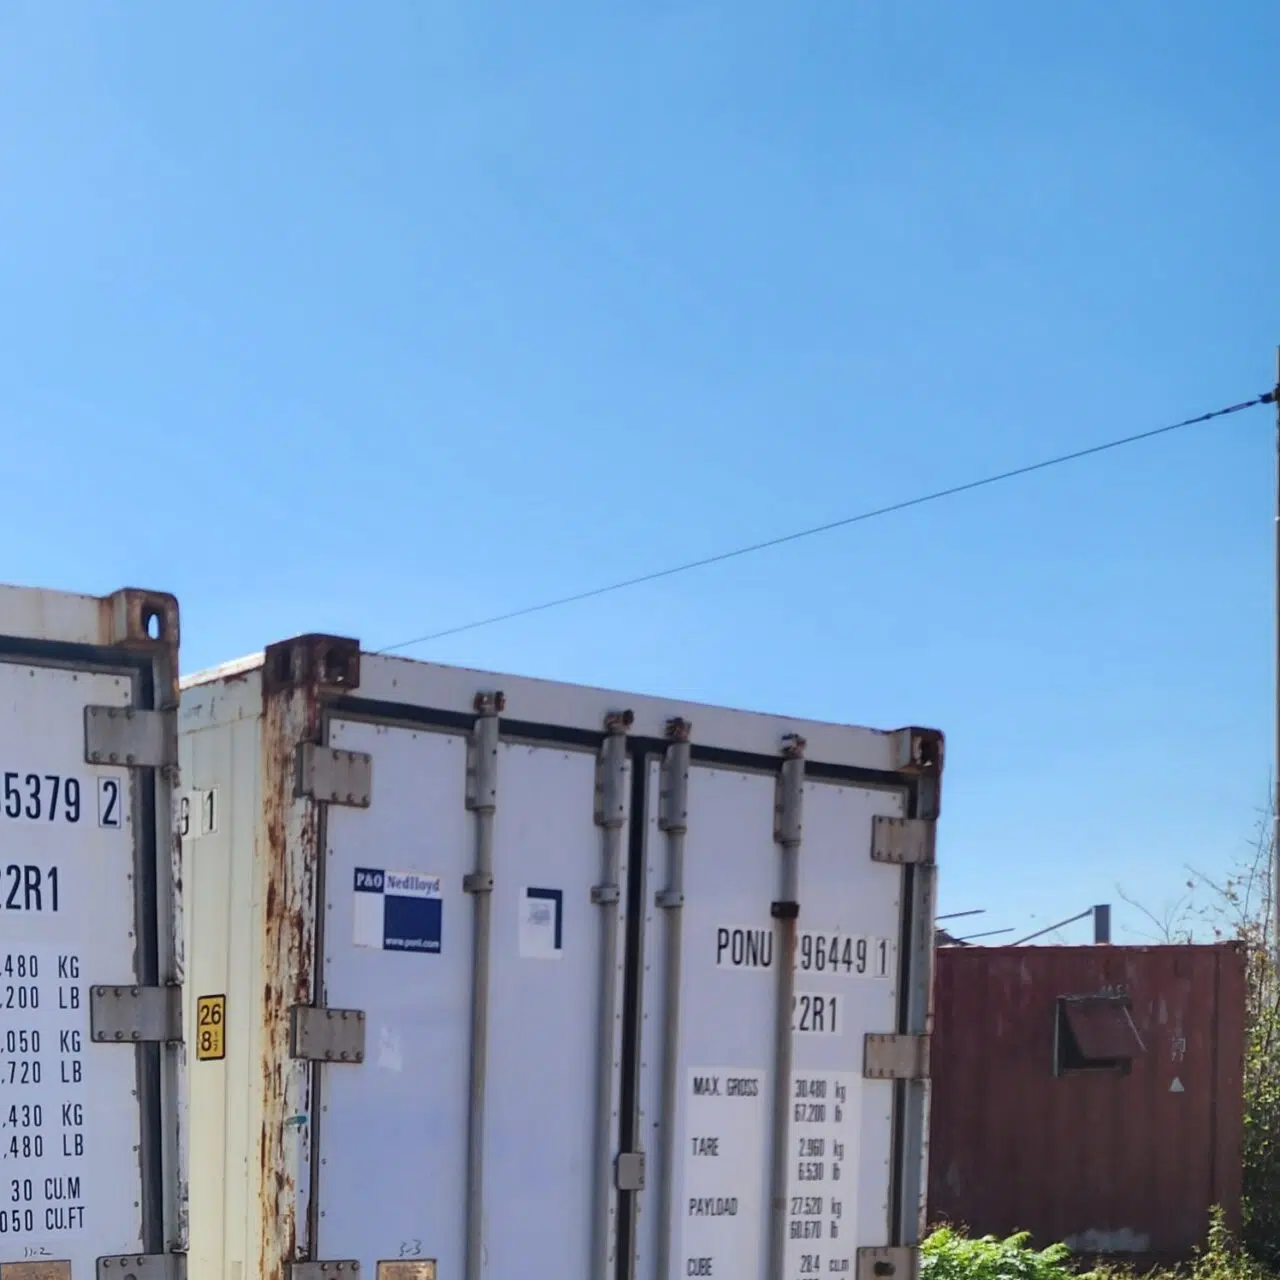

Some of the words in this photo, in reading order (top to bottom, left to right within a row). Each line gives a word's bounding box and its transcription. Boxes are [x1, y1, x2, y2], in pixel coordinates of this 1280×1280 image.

[100, 779, 119, 827] 2
[356, 872, 383, 889] P&O
[387, 875, 440, 895] Nedlloyd
[716, 928, 773, 968] PONU
[794, 934, 867, 974] 96449
[58, 955, 80, 978] KG
[59, 986, 80, 1009] LB
[200, 1004, 221, 1026] 26
[60, 1029, 81, 1053] KG
[61, 1060, 82, 1084] LB
[726, 1077, 759, 1097] GROSS
[835, 1081, 847, 1103] kg
[62, 1103, 83, 1127] KG
[835, 1104, 843, 1123] lb
[63, 1133, 84, 1157] LB
[692, 1137, 719, 1157] TARE
[833, 1139, 844, 1161] kg
[832, 1162, 841, 1181] lb
[11, 1179, 33, 1202] 30
[44, 1176, 81, 1201] CU.M
[45, 1206, 85, 1231] CU.FT
[689, 1197, 738, 1217] PAYLOAD
[830, 1197, 842, 1219] kg
[830, 1220, 839, 1239] lb
[687, 1257, 713, 1277] CUBE
